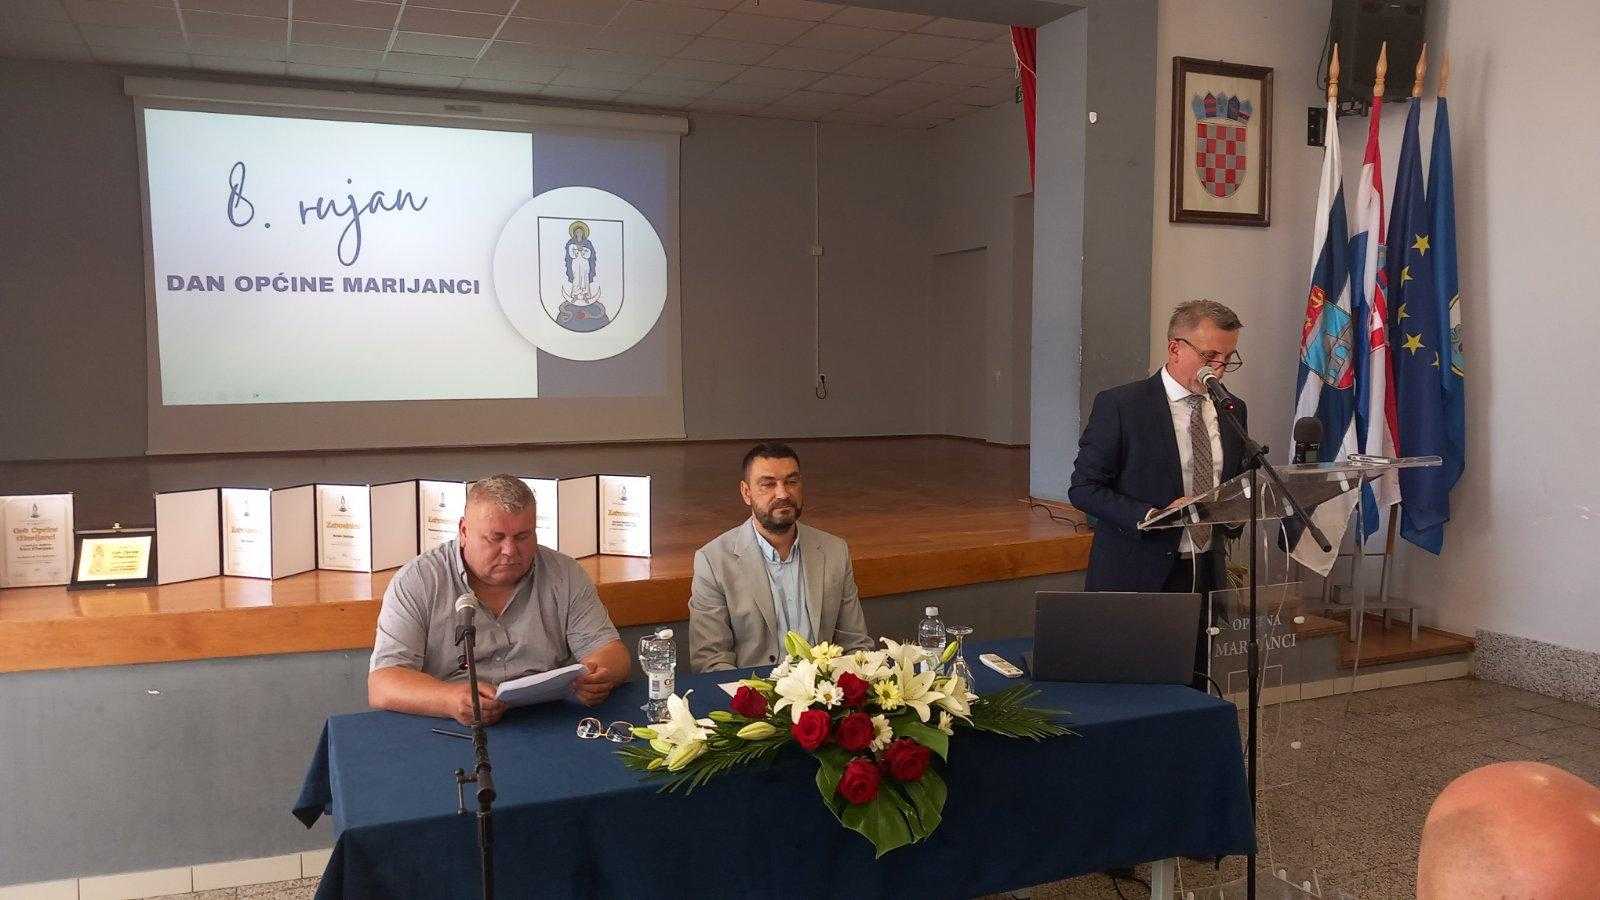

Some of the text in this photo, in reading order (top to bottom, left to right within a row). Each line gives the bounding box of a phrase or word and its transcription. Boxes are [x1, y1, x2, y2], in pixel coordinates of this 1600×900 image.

[228, 161, 428, 266] 8. rujan
[166, 272, 480, 295] DAN OPĆINE MARIJANCI
[1232, 614, 1281, 631] OPNA
[1214, 633, 1297, 657] MARANCI
